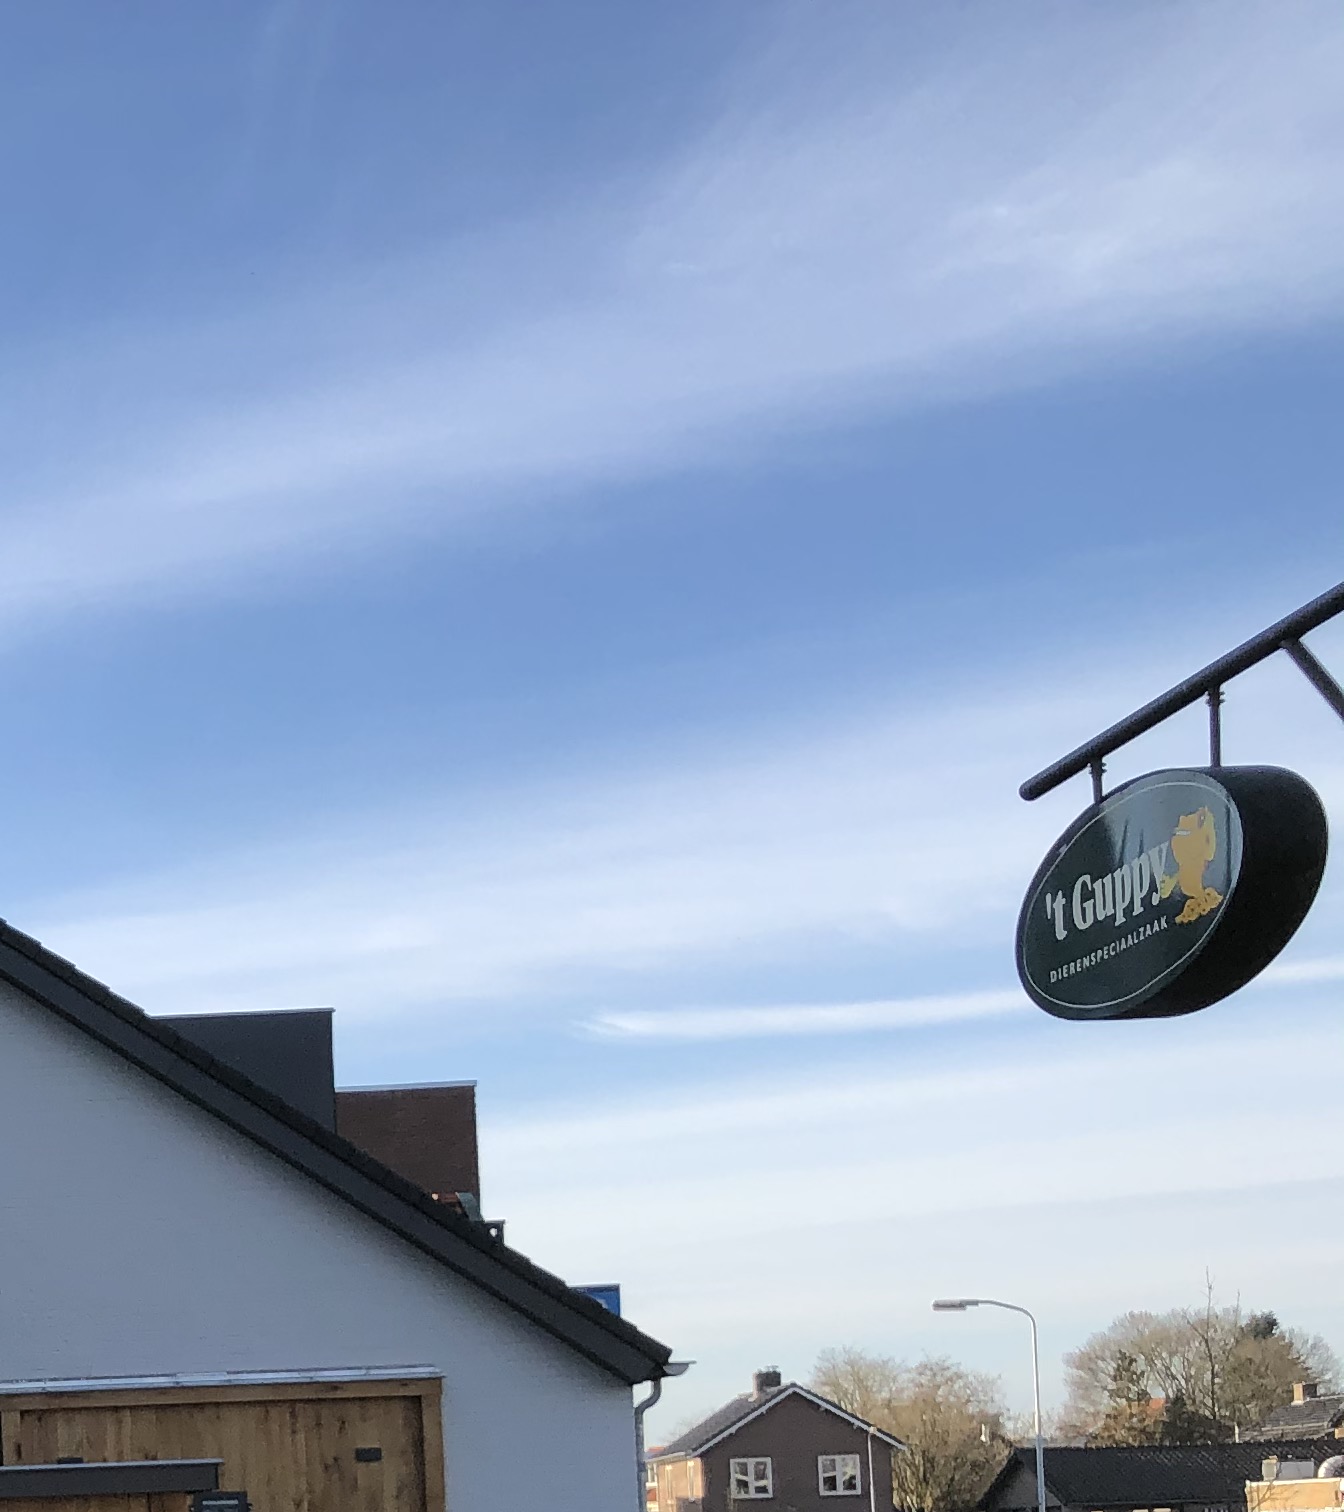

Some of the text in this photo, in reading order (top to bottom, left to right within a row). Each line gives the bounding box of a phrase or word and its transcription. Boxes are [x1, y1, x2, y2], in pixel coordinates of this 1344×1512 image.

[1045, 839, 1169, 940] 't Guppy
[1049, 915, 1168, 983] DIERENSPECIAALZAAK
